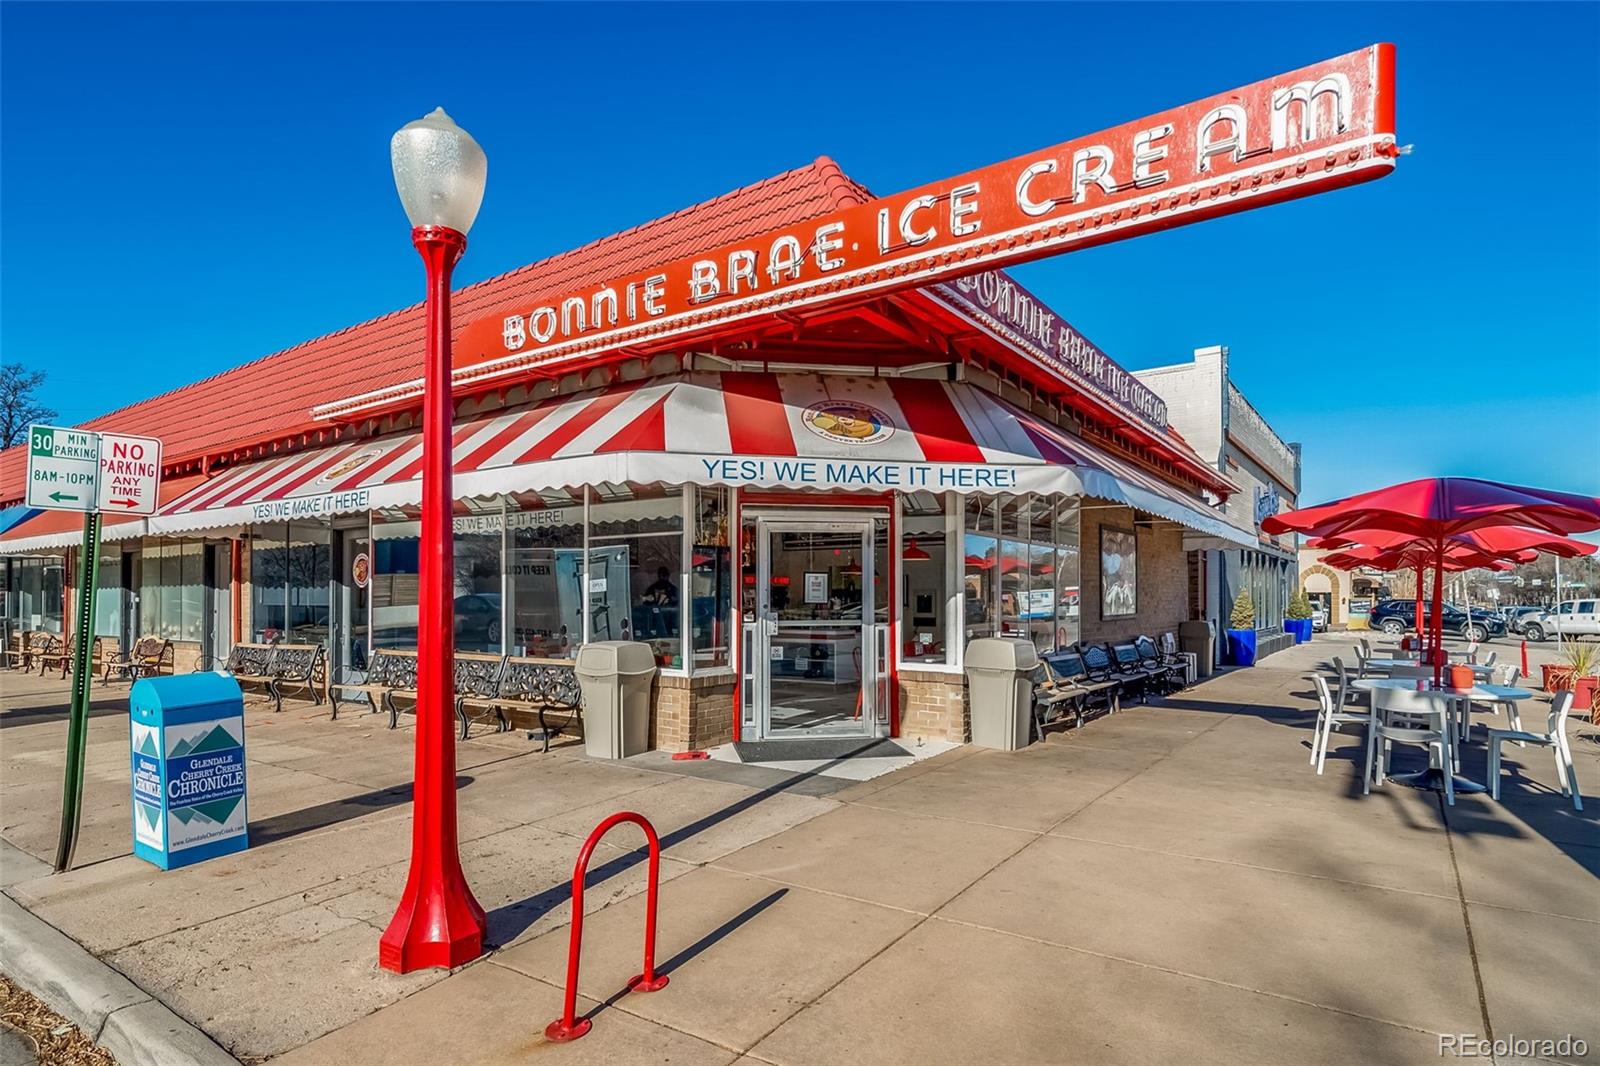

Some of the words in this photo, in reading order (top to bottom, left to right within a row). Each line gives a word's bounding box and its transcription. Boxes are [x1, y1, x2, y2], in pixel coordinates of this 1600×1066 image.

[503, 273, 667, 350] BONNIE
[877, 182, 981, 256] ICE
[1015, 72, 1350, 216] CREAM
[33, 433, 52, 450] 30
[67, 434, 87, 446] MIN
[55, 445, 96, 460] PARKING
[113, 442, 144, 460] NO
[101, 458, 154, 477] PARKING
[702, 458, 764, 480] YES!
[773, 461, 817, 482] WE
[826, 464, 900, 485] MAKE
[908, 466, 932, 486] IT
[939, 467, 1016, 488] HERE!
[113, 476, 141, 486] ANY
[111, 486, 142, 497] TIME
[252, 500, 274, 519] YES!
[274, 500, 290, 516] WE
[292, 498, 320, 514] MAKE
[322, 496, 334, 511] IT
[335, 490, 370, 510] HERE!
[467, 518, 483, 530] WE
[486, 514, 514, 528] MAE
[515, 513, 527, 526] IT
[530, 510, 564, 524] HERE!
[190, 755, 233, 769] GLENDALE
[180, 768, 214, 782] CHERRY
[215, 763, 242, 775] CREEK
[168, 771, 244, 798] CHRONICLE
